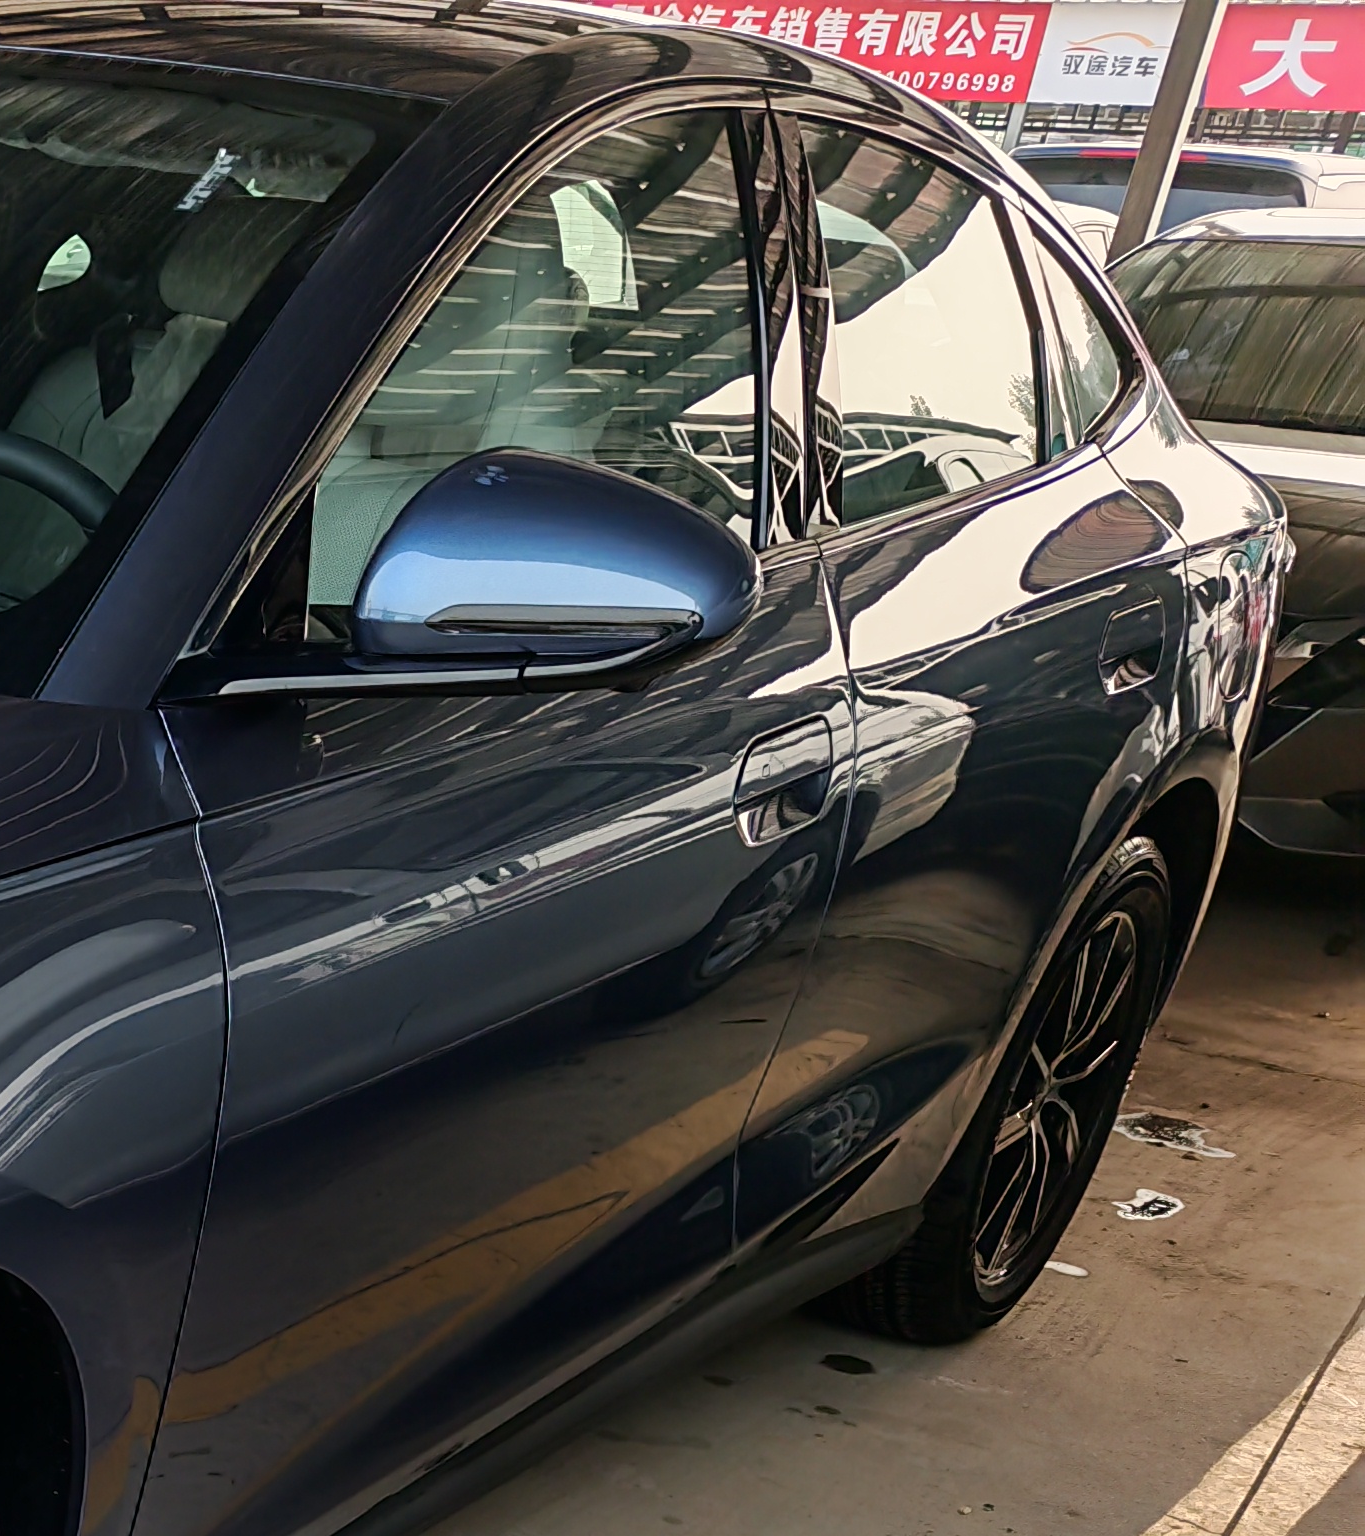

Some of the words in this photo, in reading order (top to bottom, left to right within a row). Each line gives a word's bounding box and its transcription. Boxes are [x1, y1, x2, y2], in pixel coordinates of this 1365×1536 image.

[1062, 54, 1158, 77] 驭途汽车
[1239, 19, 1338, 97] 大
[873, 69, 1015, 92] 100796998
